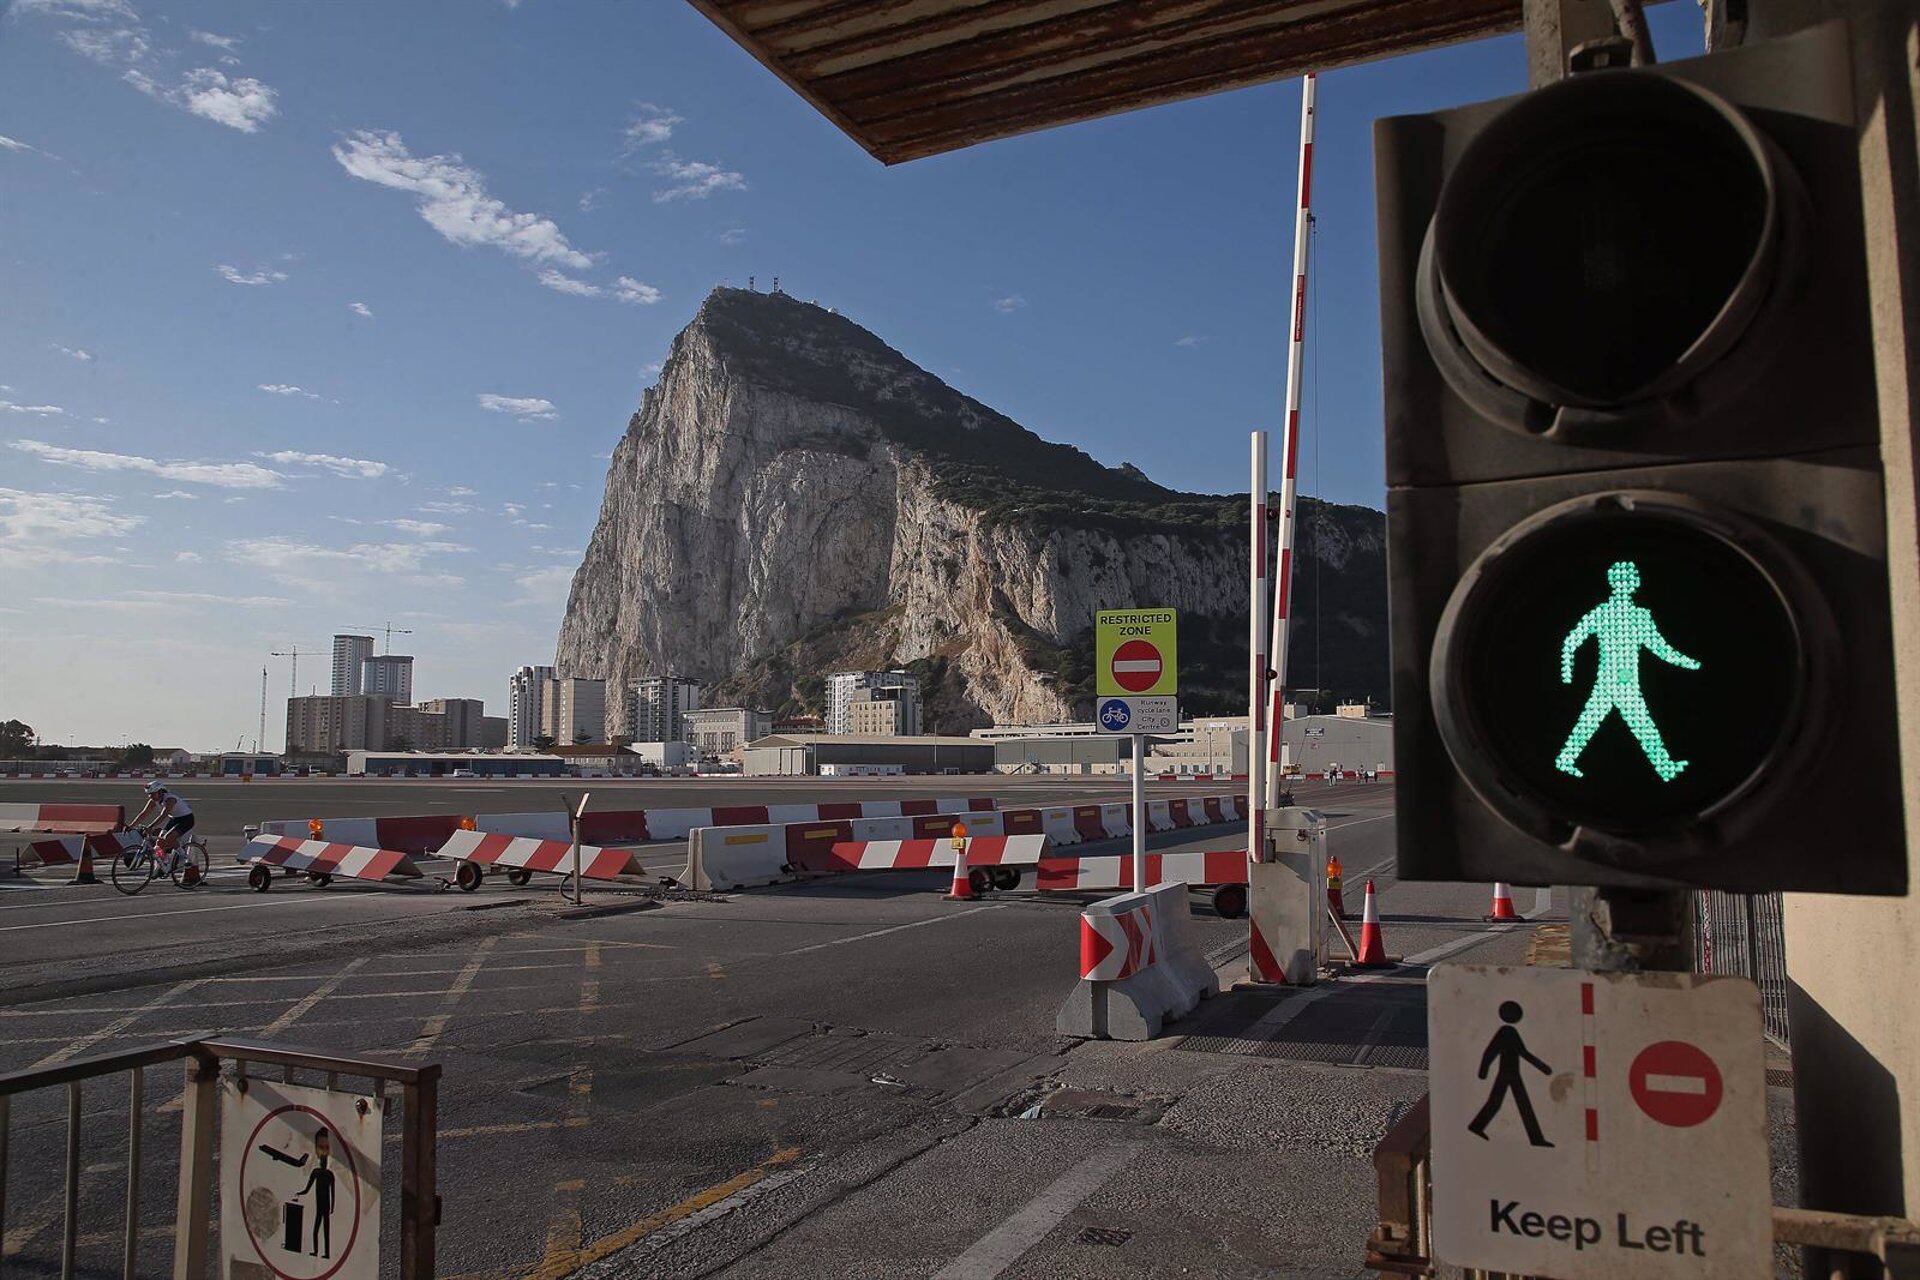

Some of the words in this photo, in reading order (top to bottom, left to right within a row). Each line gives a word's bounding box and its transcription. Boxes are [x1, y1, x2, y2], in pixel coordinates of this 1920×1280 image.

[1100, 614, 1172, 624] RESTRICTED
[1119, 626, 1152, 636] ZONE
[1490, 1199, 1602, 1251] Keep
[1617, 1212, 1706, 1257] Left
